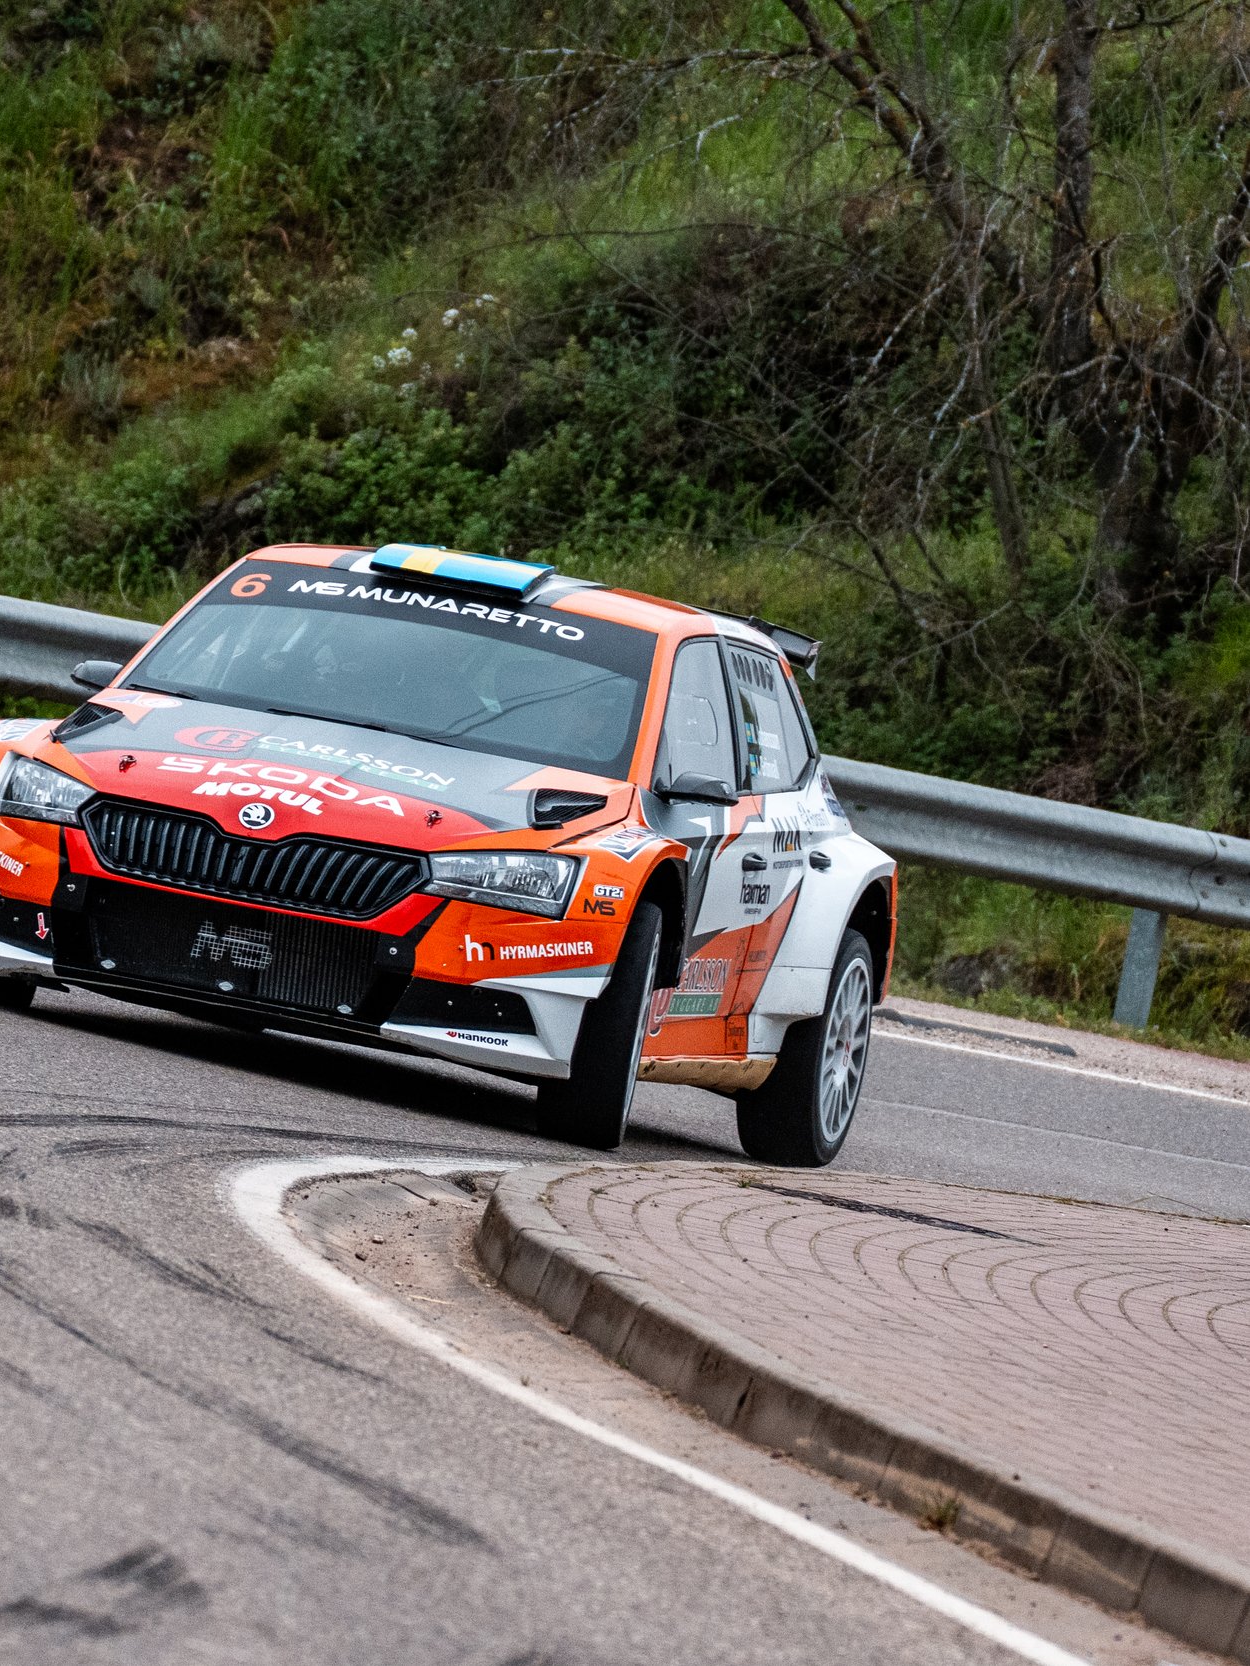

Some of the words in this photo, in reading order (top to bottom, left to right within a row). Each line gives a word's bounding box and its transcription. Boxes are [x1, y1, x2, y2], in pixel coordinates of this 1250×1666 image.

[230, 573, 272, 598] 6
[287, 579, 349, 596] MS
[347, 585, 585, 641] MUNARETTO
[257, 735, 456, 786] CARLSSON
[192, 781, 324, 816] MOTUL
[583, 898, 616, 916] MS
[500, 941, 594, 960] HYRMASKINER
